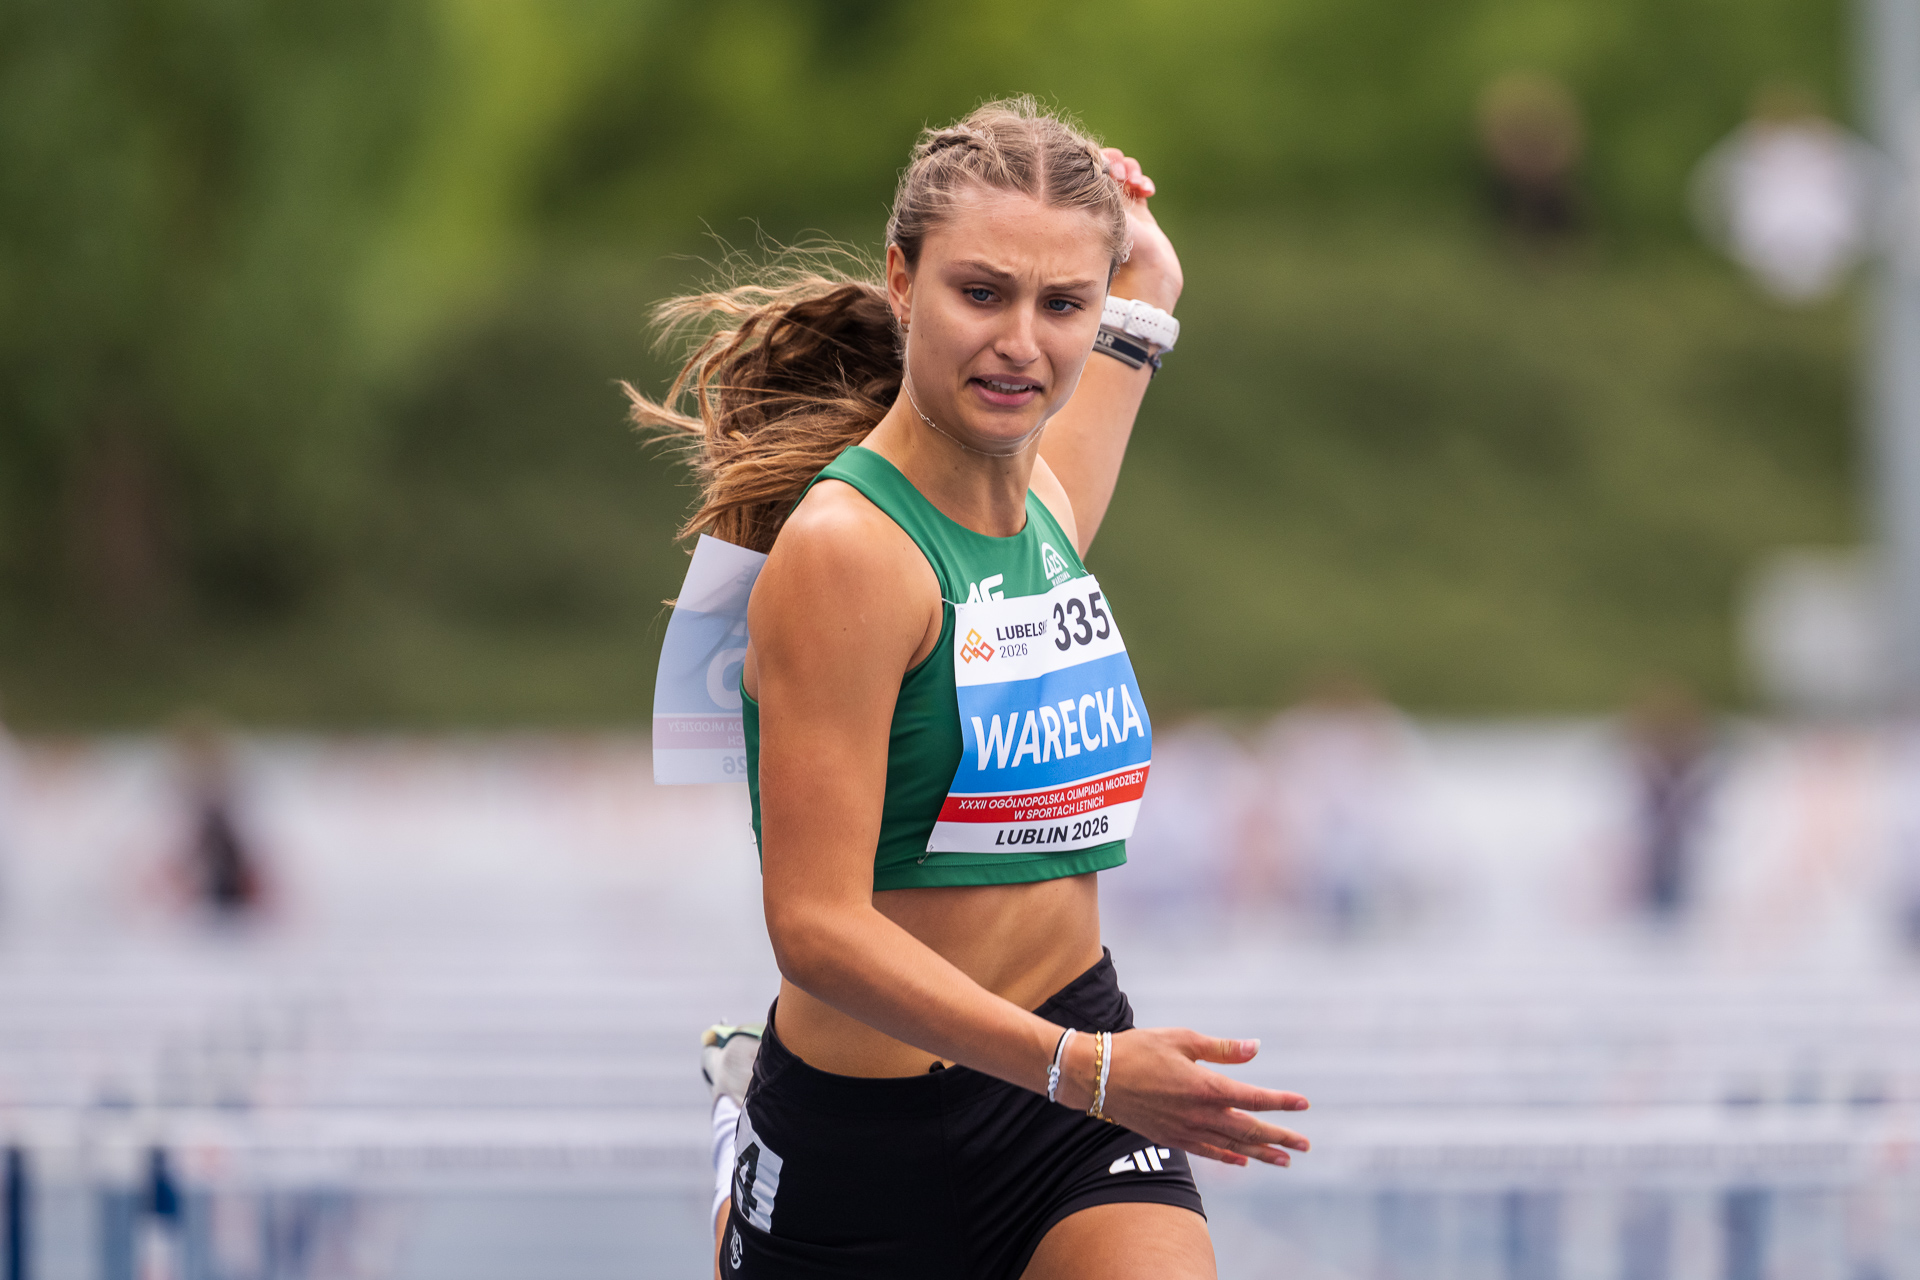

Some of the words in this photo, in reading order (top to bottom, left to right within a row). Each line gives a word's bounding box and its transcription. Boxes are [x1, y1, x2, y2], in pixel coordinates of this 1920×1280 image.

[1053, 591, 1110, 651] 335
[999, 643, 1028, 658] 2026
[971, 684, 1144, 771] WARECKA
[959, 800, 987, 810] XXXII
[989, 792, 1065, 809] OGÓLNOPOLSKA
[1067, 782, 1104, 801] OLIMPIADA
[1105, 770, 1144, 791] MŁODZIEŻY
[1014, 810, 1025, 820] W
[1026, 802, 1075, 819] SPORTACH
[1076, 795, 1104, 813] LETNICH
[995, 826, 1068, 845] LUBLIN
[1072, 815, 1109, 841] 2026
